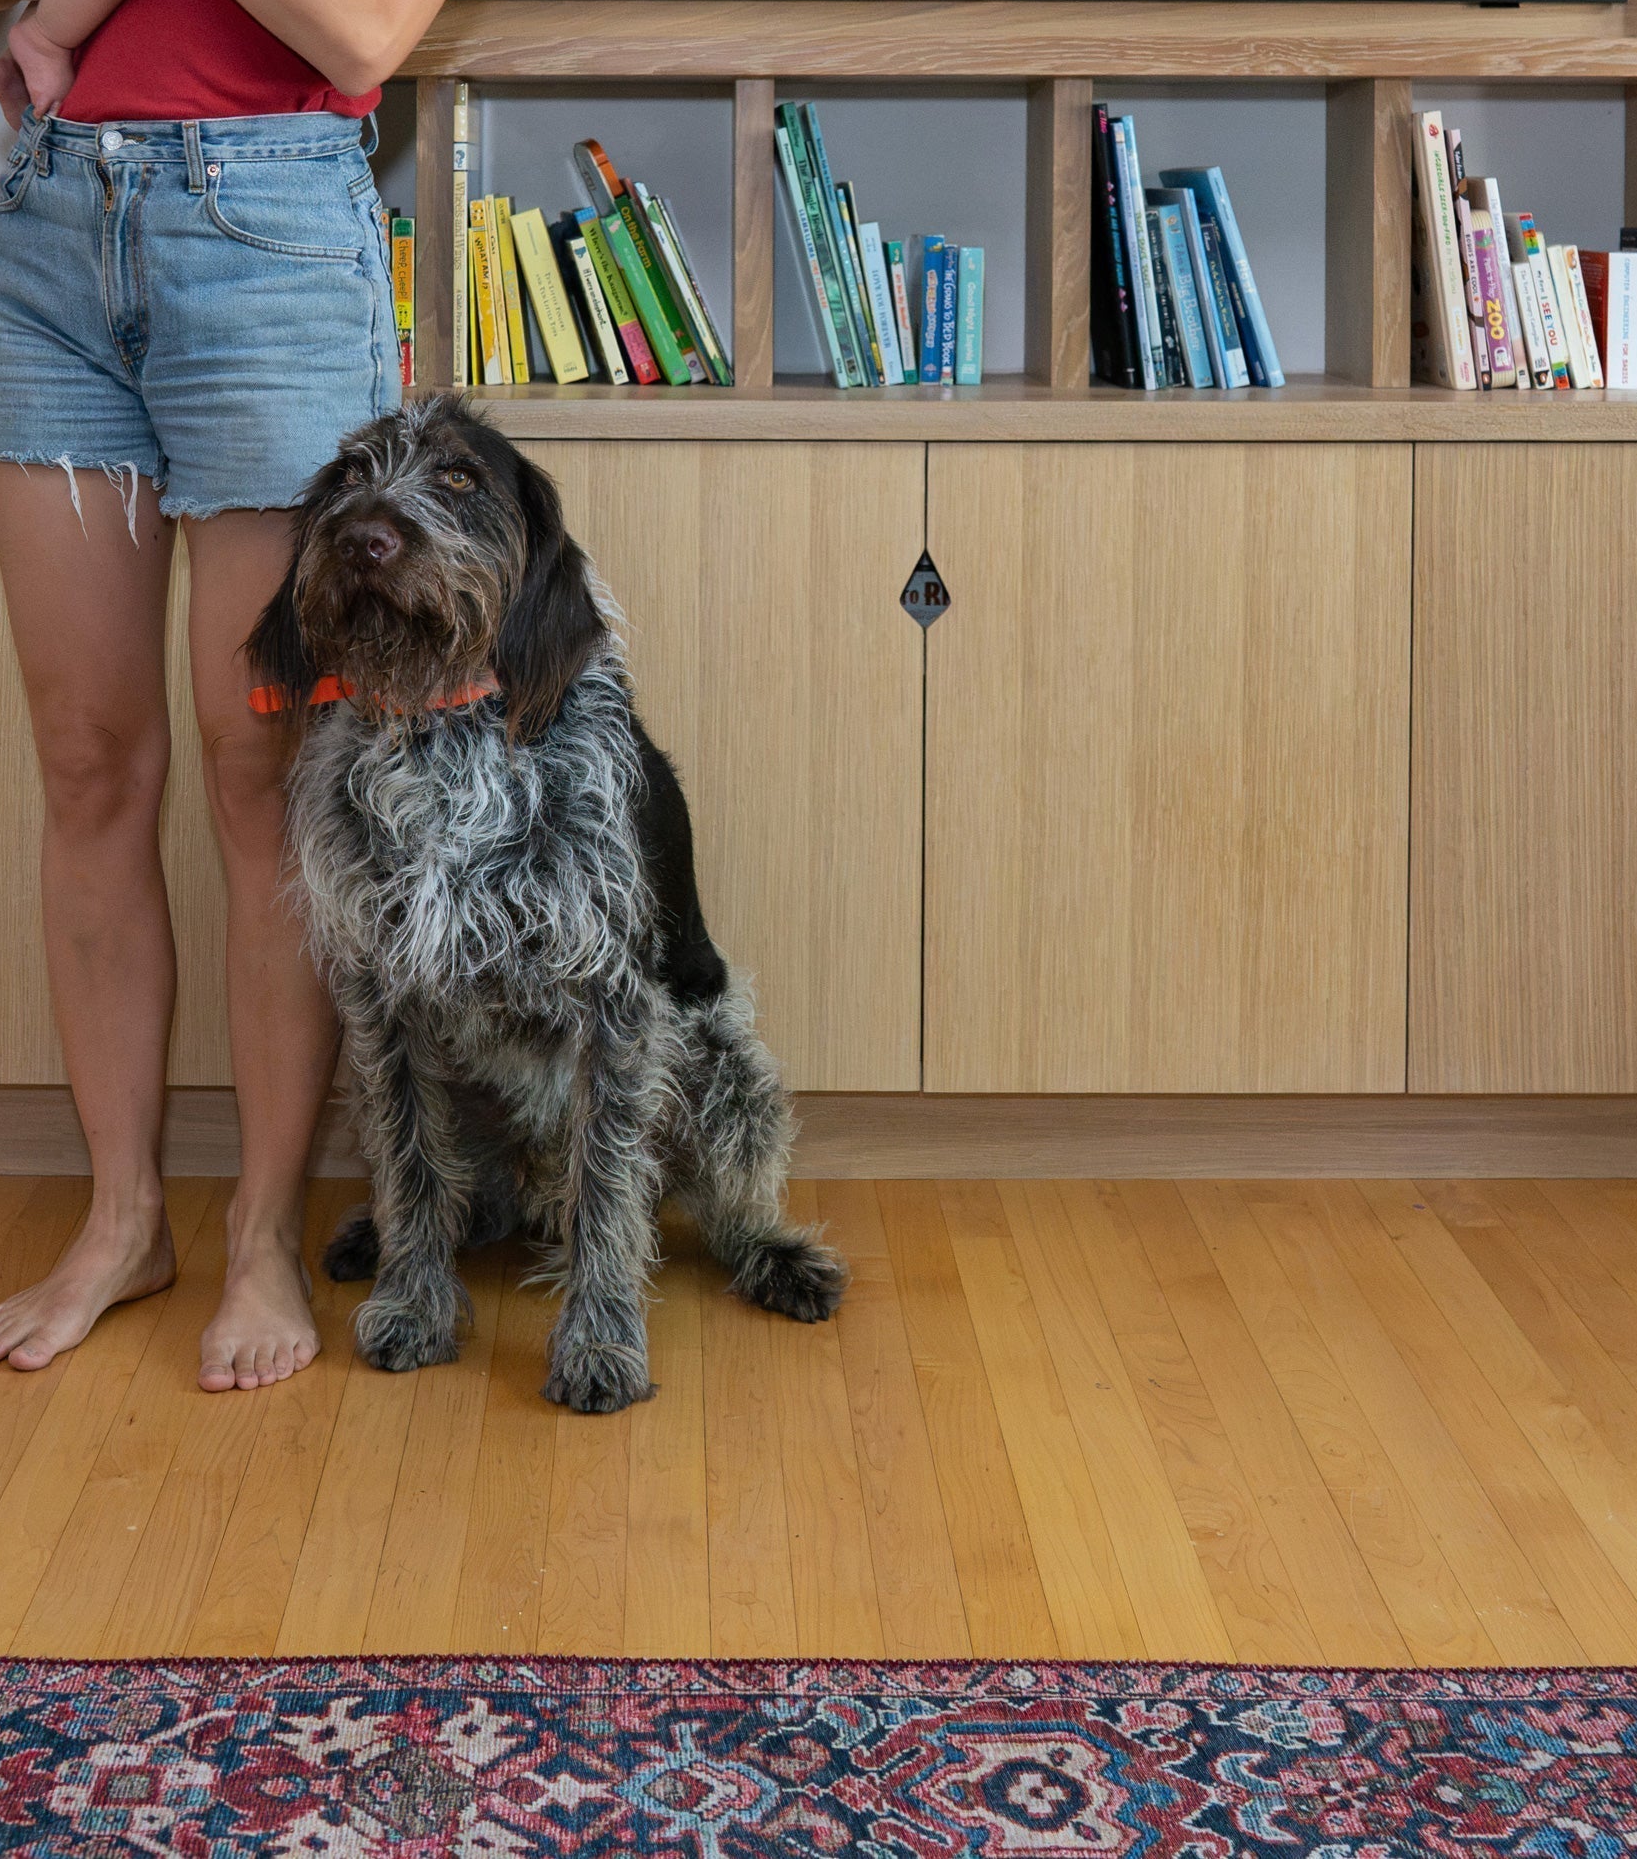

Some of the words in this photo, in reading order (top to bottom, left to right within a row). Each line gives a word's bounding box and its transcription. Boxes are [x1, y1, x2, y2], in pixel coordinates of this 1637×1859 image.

[454, 182, 464, 215] Wheels
[455, 216, 464, 236] and
[621, 206, 631, 222] On
[626, 224, 639, 240] the
[635, 240, 652, 268] Farm
[454, 237, 465, 270] Wings
[474, 238, 484, 262] WHAT
[481, 264, 488, 280] AM
[1178, 274, 1191, 298] Big
[1486, 300, 1504, 340] ZOO
[1542, 303, 1553, 320] SEE
[1546, 323, 1557, 346] YOU
